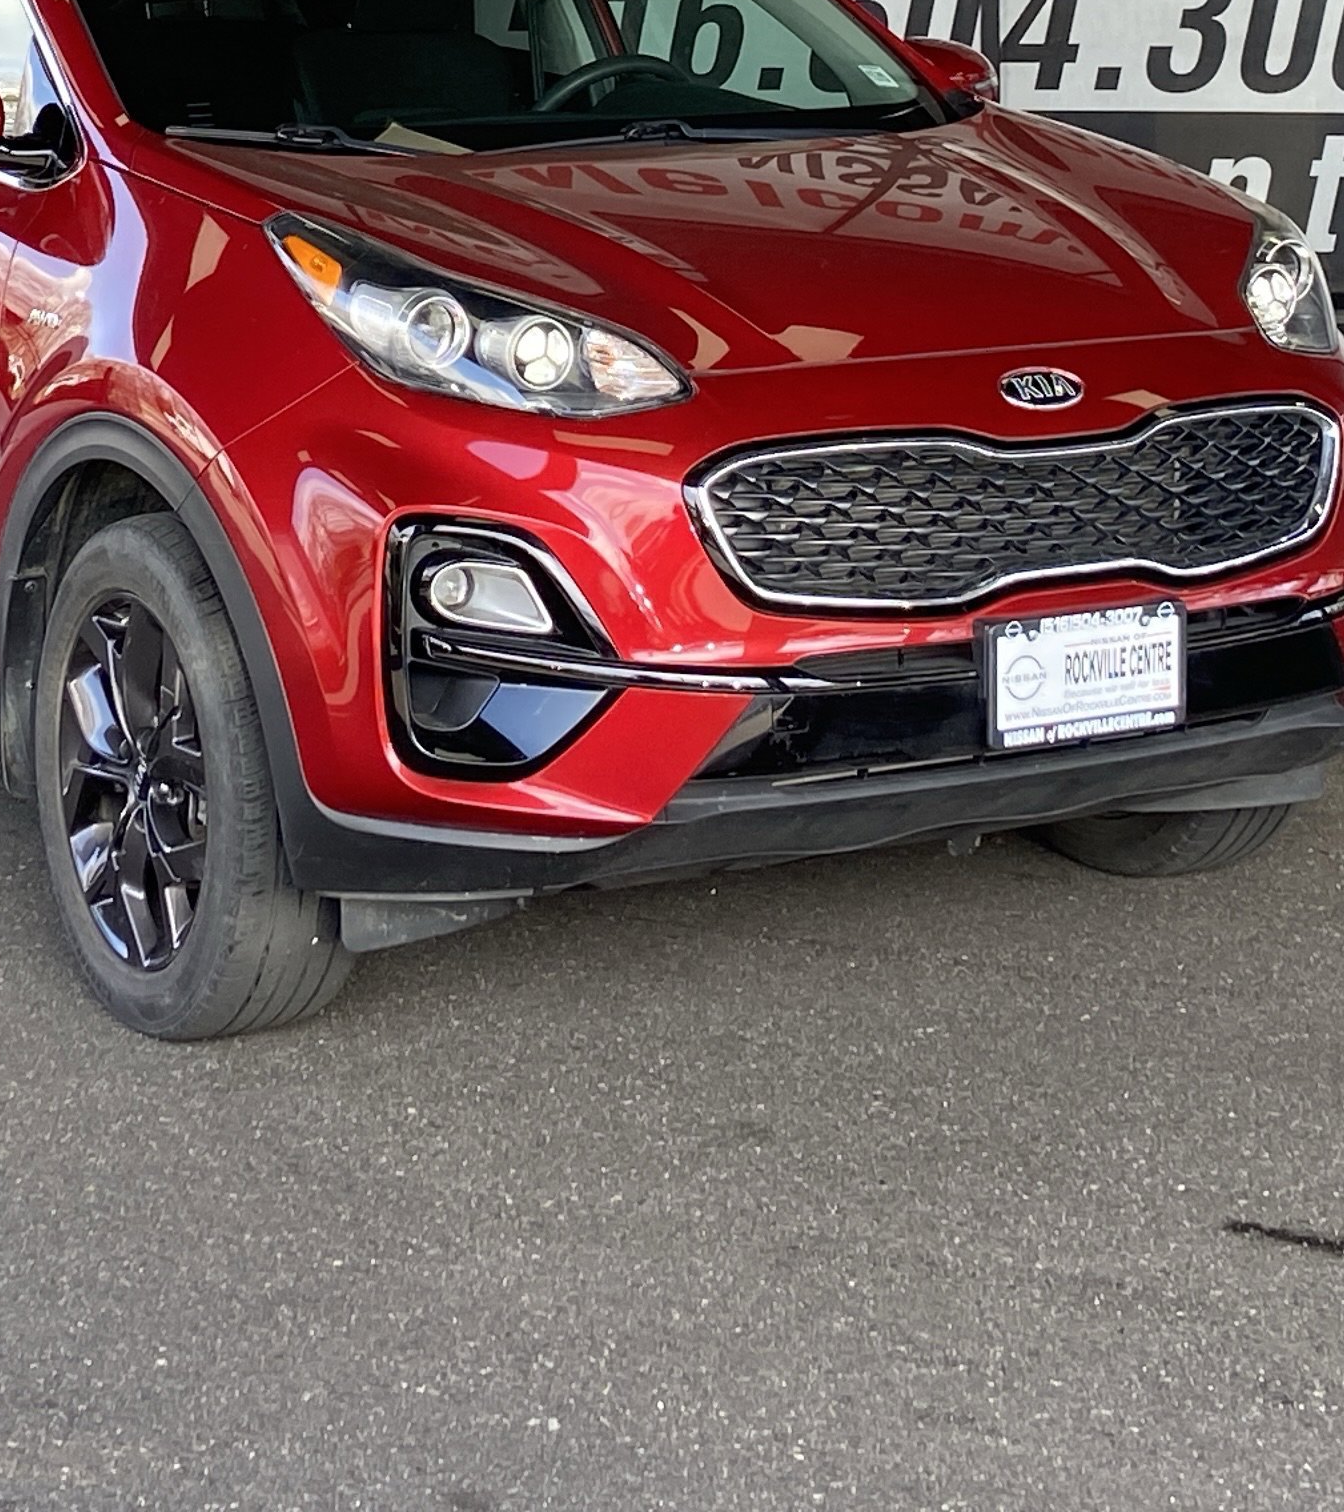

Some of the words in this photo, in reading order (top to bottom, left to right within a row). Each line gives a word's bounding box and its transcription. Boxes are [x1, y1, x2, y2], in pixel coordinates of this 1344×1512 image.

[1012, 373, 1076, 400] KIA
[1064, 646, 1126, 685] ROCKVILLE
[1129, 640, 1172, 676] CENTRE
[1002, 671, 1047, 685] NISSAN
[1004, 727, 1044, 748] NISSAN
